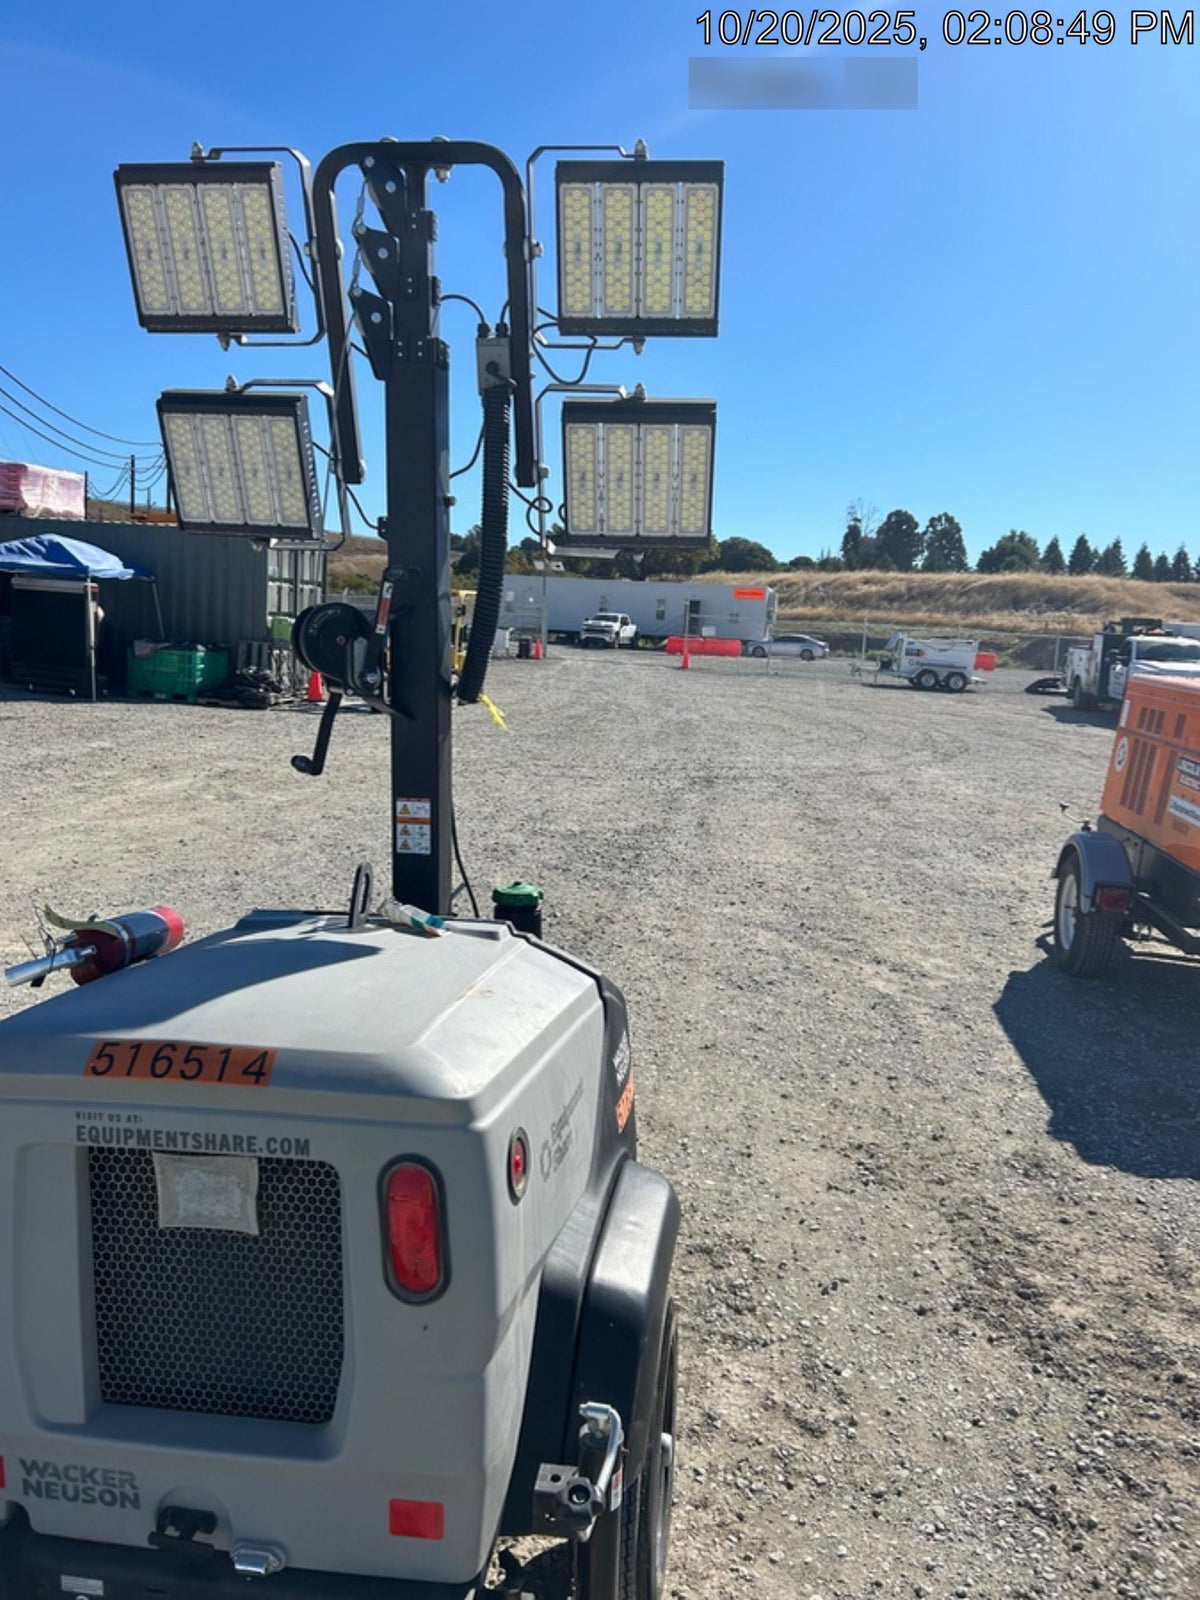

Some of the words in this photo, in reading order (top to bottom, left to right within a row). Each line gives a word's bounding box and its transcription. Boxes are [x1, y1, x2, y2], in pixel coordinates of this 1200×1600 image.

[90, 1041, 270, 1085] 516514
[75, 1110, 103, 1122] VISIT
[108, 1112, 121, 1123] US
[126, 1113, 143, 1124] AT:
[76, 1124, 311, 1157] EQUIPMENTSHARE.COM
[18, 1457, 140, 1491] WACKER
[22, 1478, 141, 1511] NEUSON
